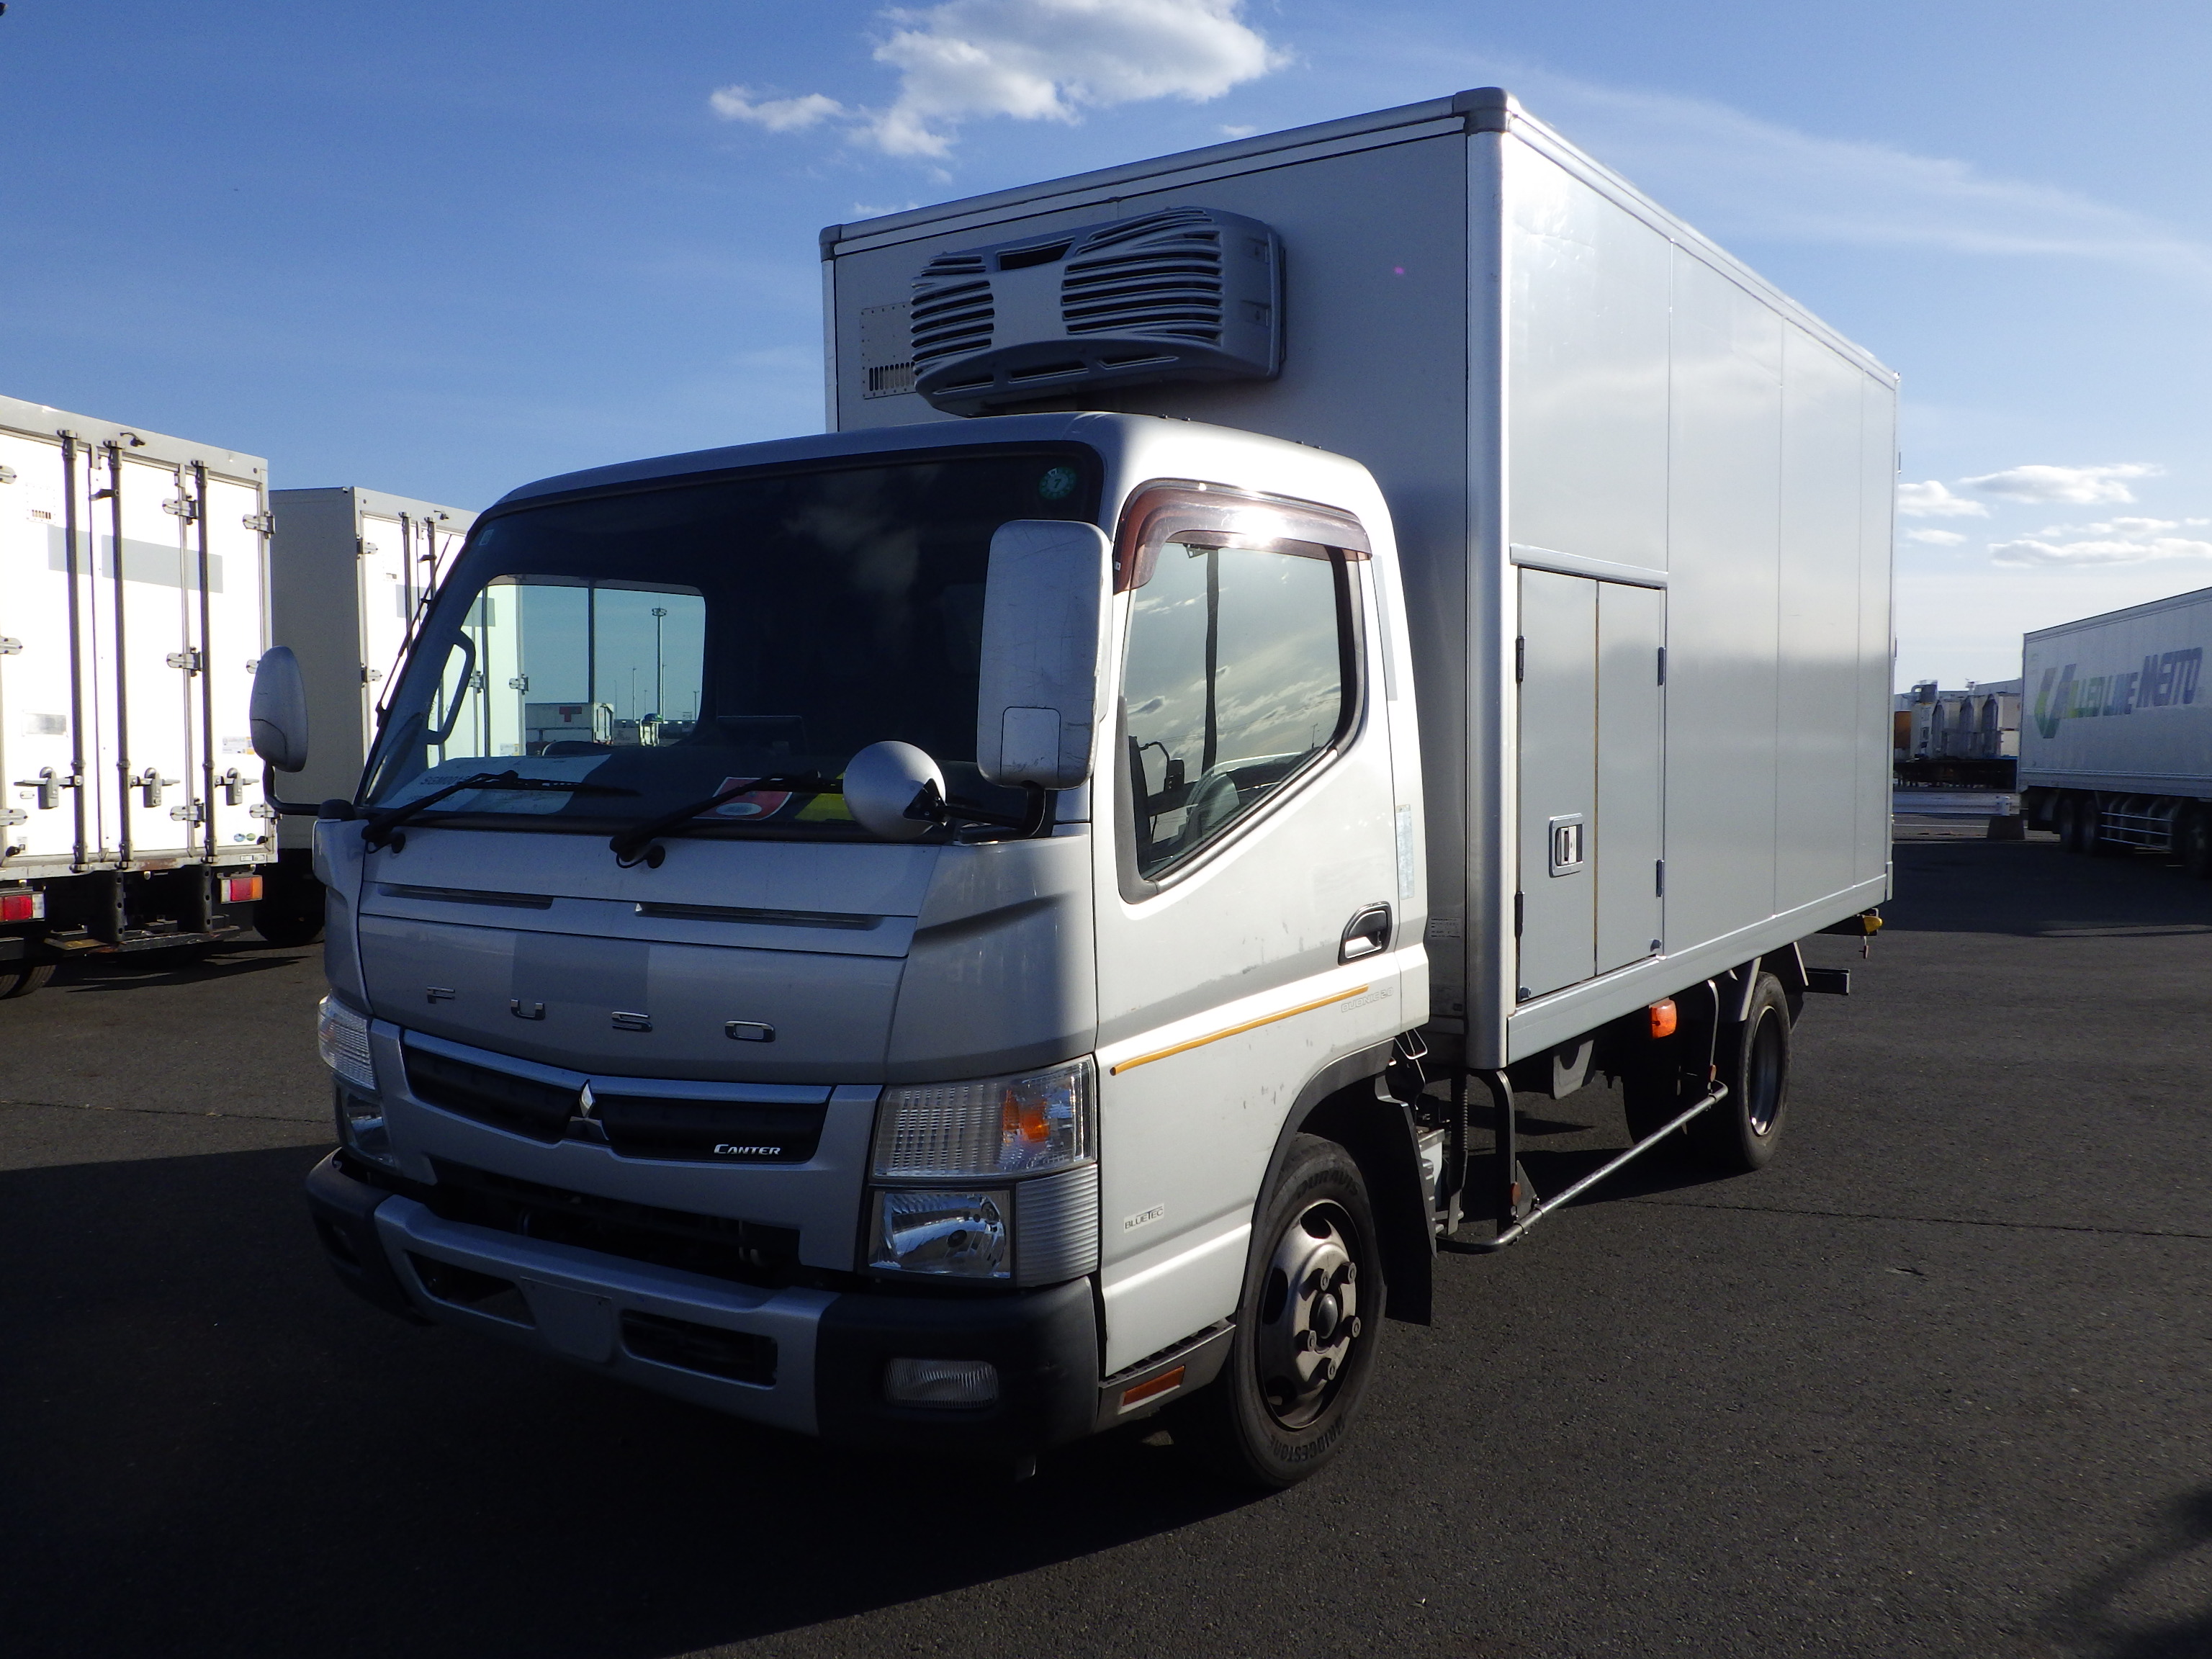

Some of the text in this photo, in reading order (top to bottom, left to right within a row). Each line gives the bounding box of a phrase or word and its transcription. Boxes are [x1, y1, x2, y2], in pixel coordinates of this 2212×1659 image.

[1341, 986, 1394, 1013] DUONIC 2.0
[427, 985, 775, 1042] FUSO
[714, 1143, 781, 1156] CANTER
